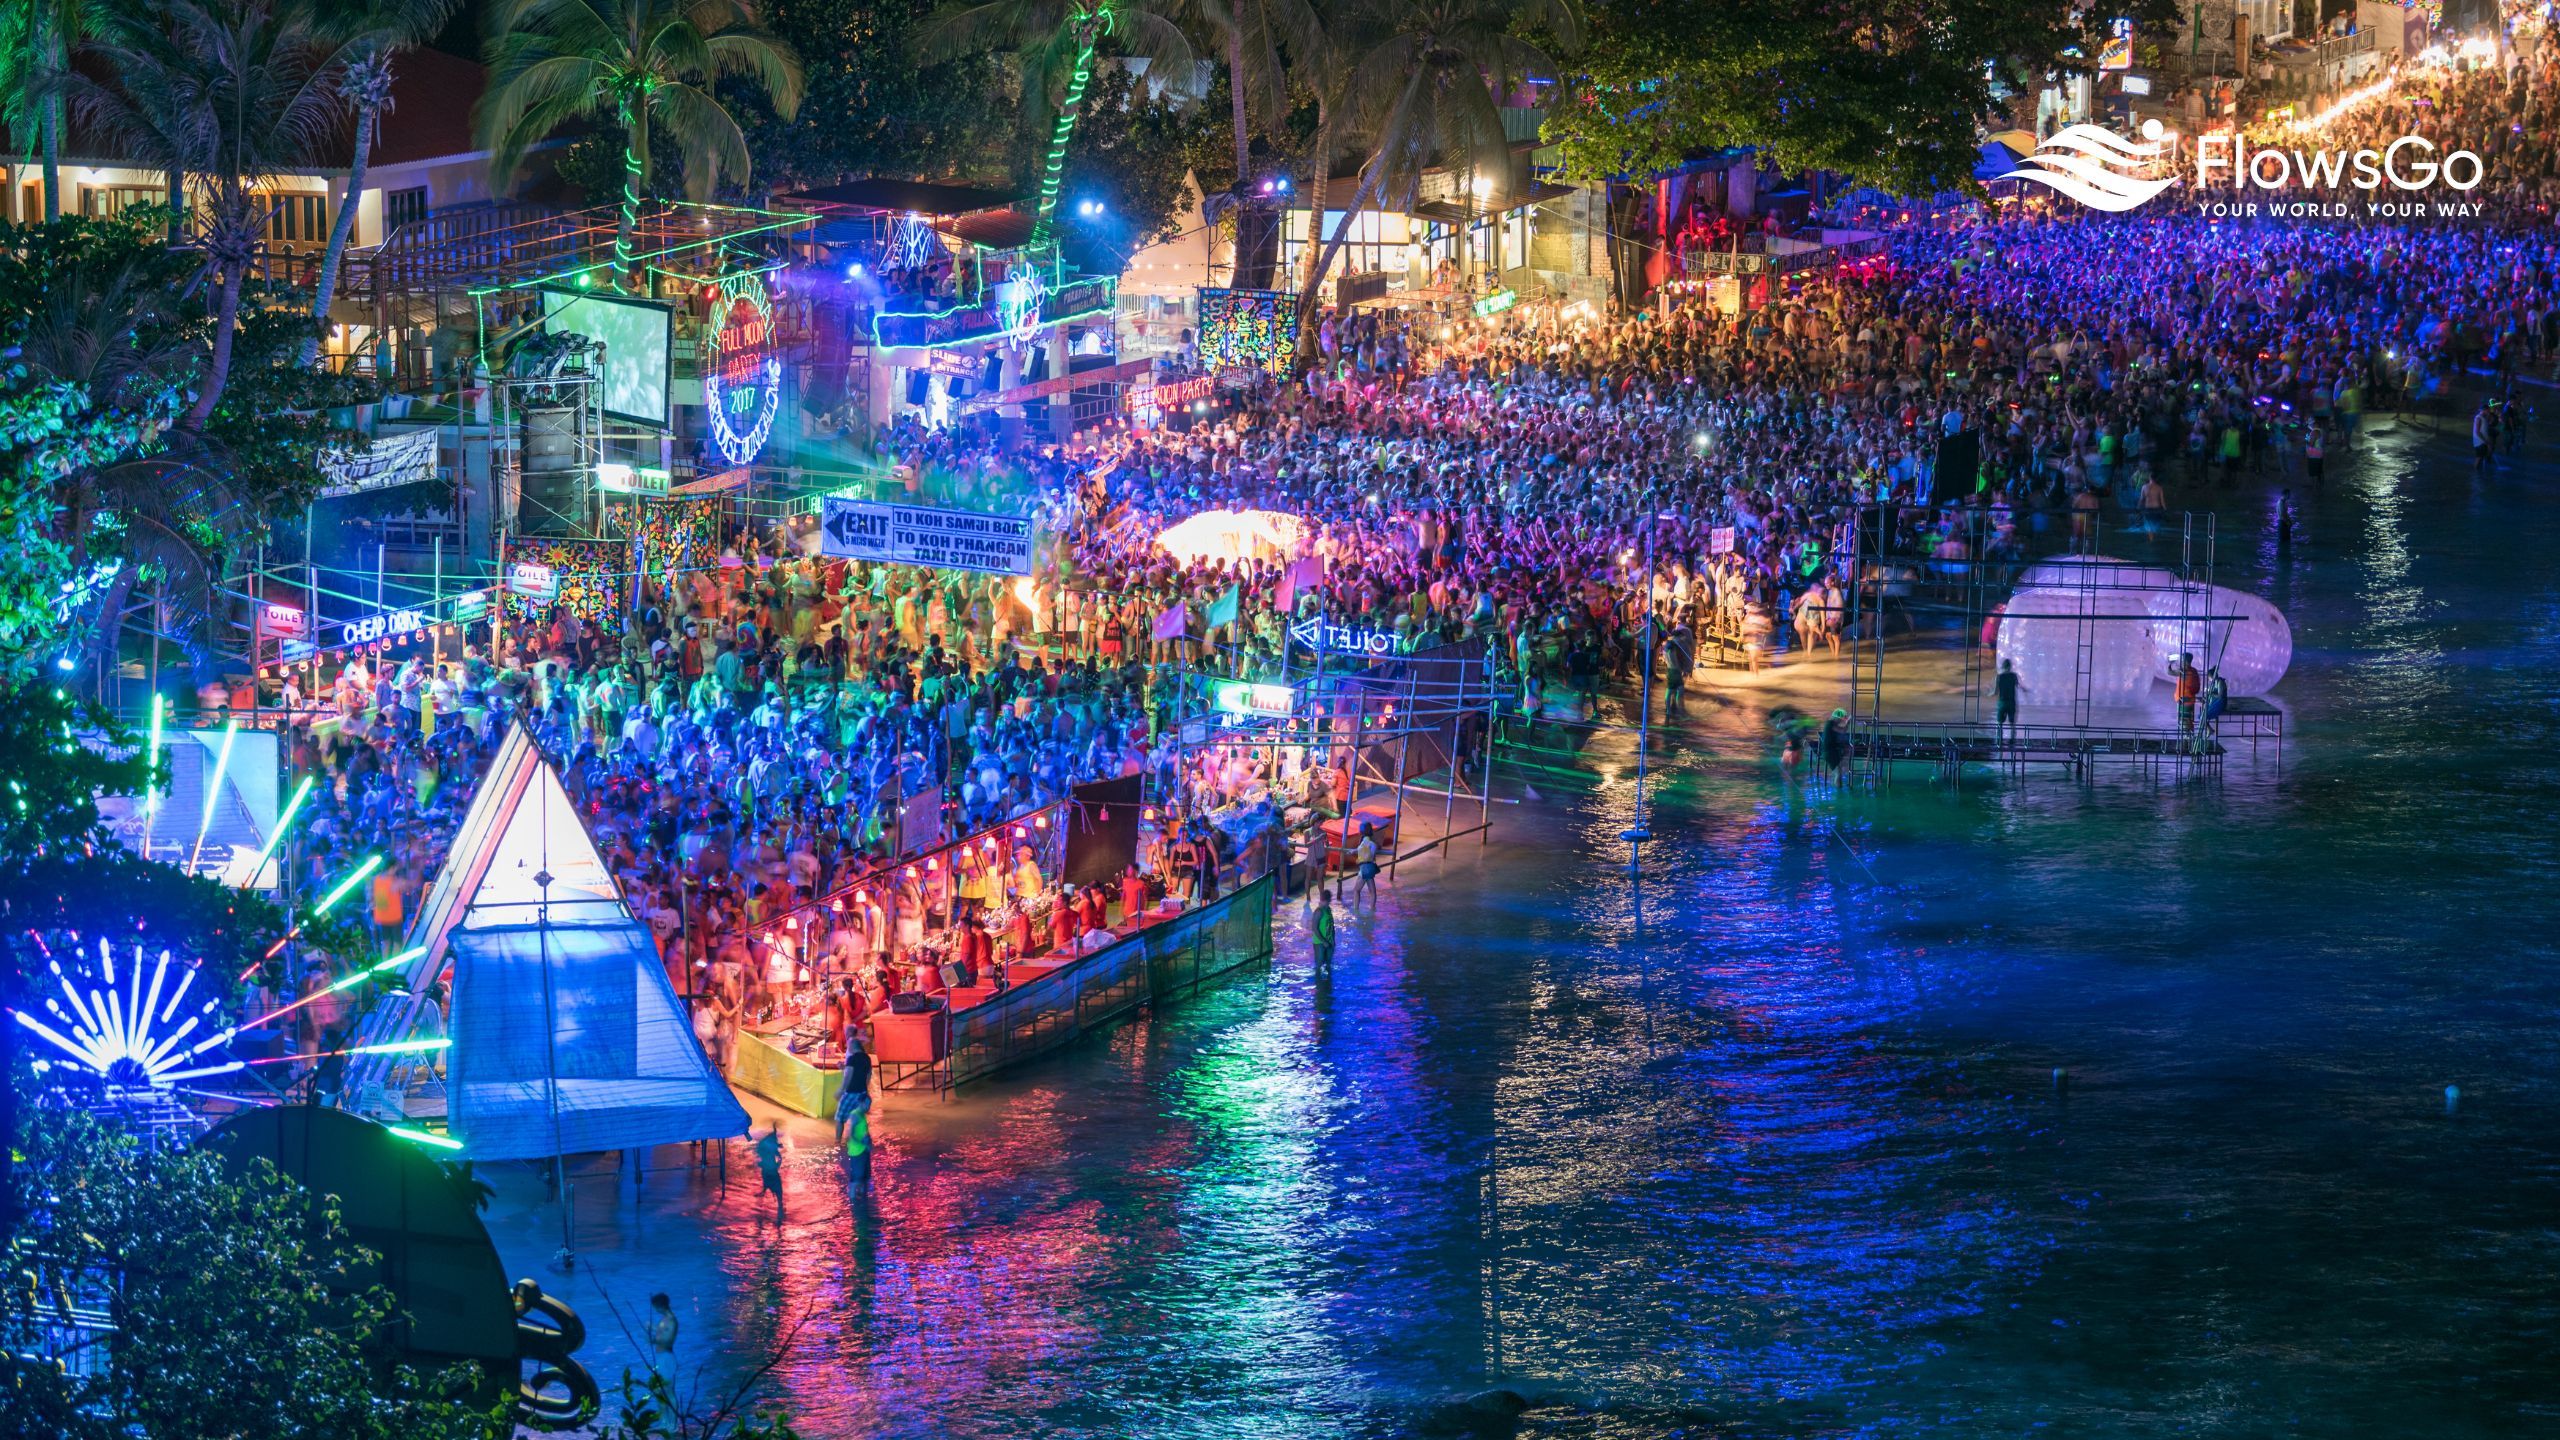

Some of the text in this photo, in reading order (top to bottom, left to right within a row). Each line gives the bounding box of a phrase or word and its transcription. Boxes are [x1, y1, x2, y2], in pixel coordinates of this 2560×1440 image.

[723, 273, 776, 345] ORIGINAL
[722, 320, 765, 354] FULL MOON
[728, 352, 760, 387] PARTY
[936, 363, 975, 377] ENTRANCE
[731, 387, 755, 414] 2017
[1155, 382, 1178, 408] MOON
[1181, 376, 1214, 401] PARTY
[846, 512, 890, 536] EXIT
[895, 511, 913, 524] TO
[916, 513, 943, 528] KOH
[993, 521, 1028, 536] BOAT
[846, 536, 852, 546] 5
[895, 531, 1027, 557] TO KOH PHANGAN
[913, 547, 1011, 569] TAXI STATION
[263, 609, 306, 624] TOILET
[343, 616, 386, 644] CHEAP
[1241, 691, 1294, 712] TOILET
